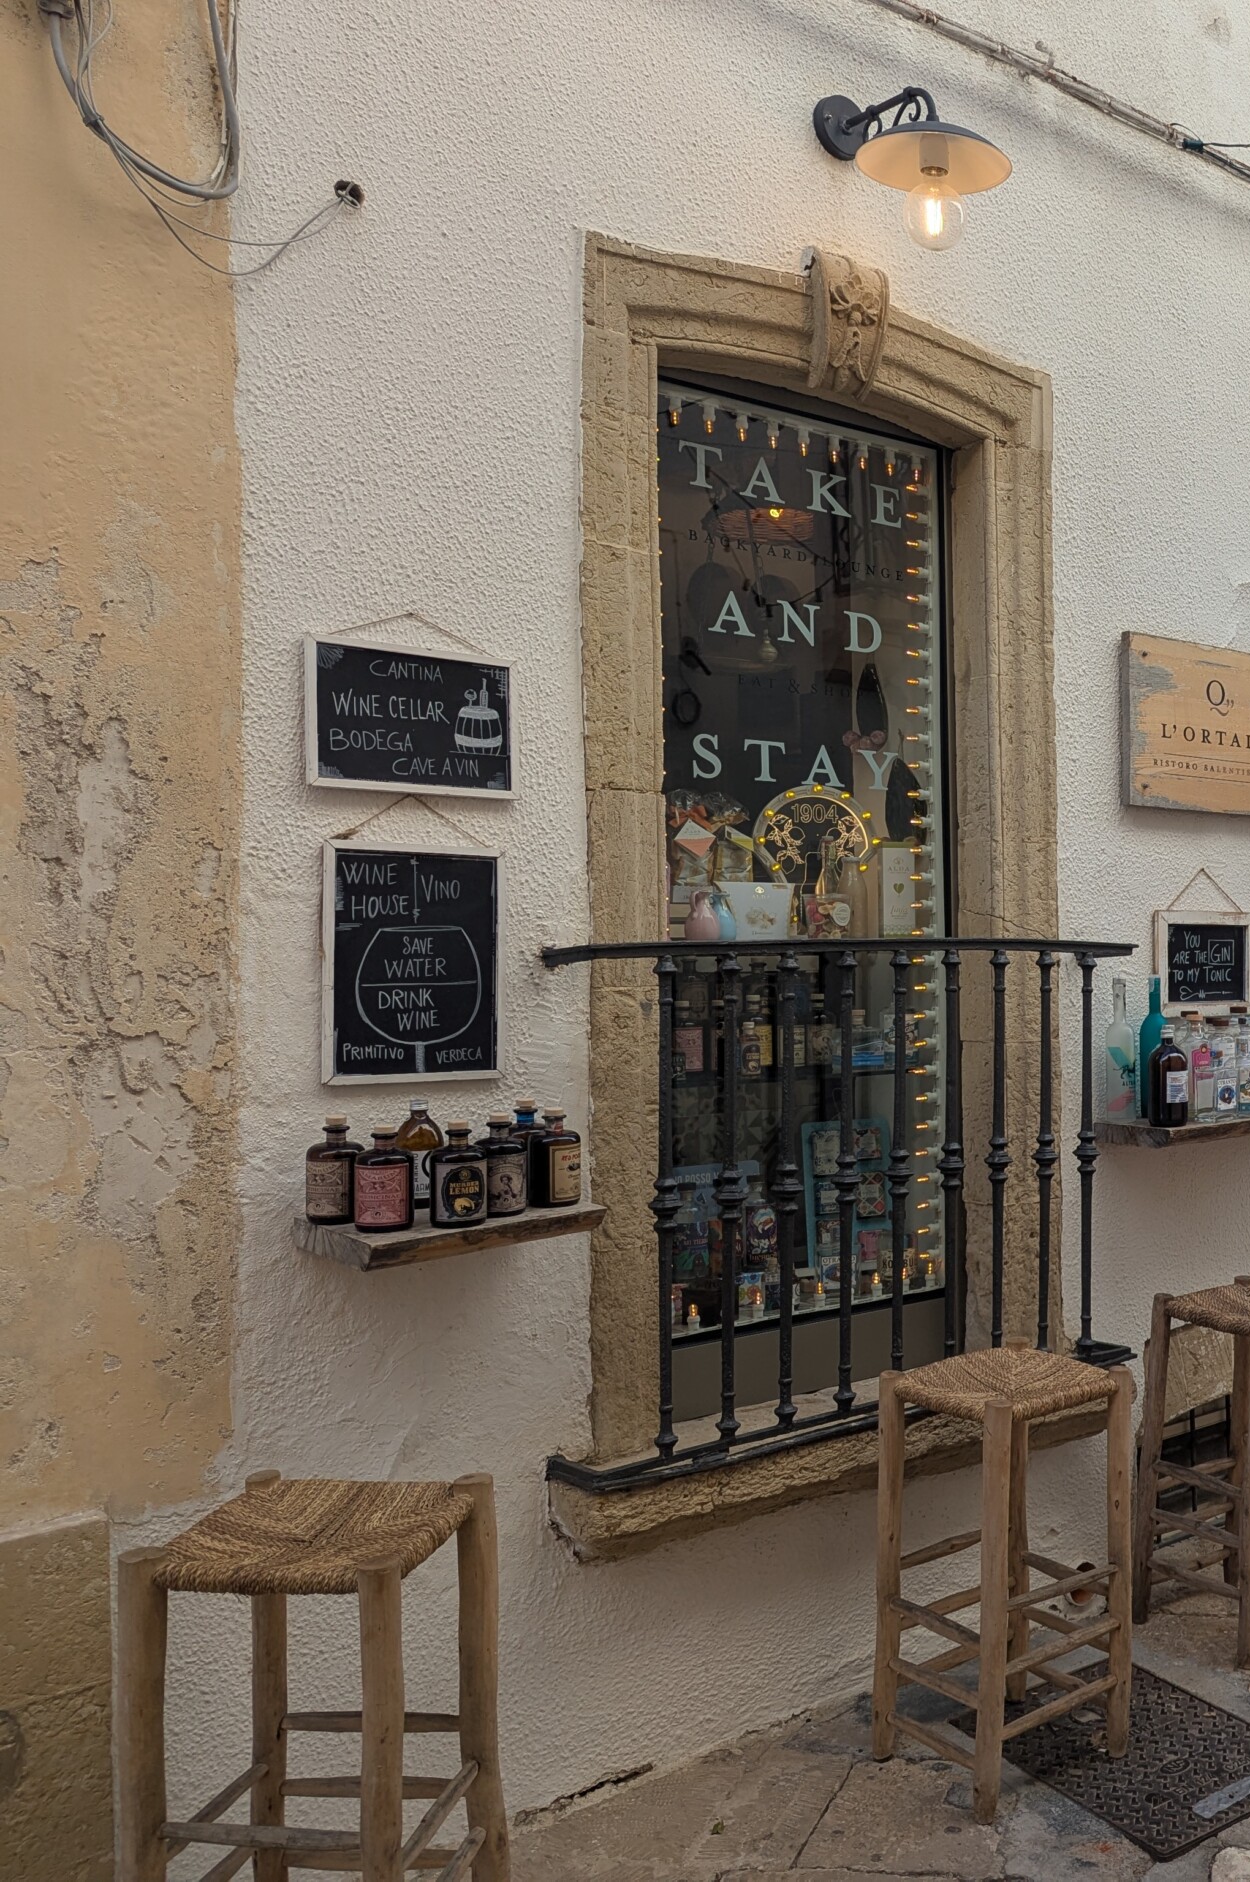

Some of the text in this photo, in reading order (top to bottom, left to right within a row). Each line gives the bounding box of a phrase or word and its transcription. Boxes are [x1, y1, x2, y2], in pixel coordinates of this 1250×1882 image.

[678, 439, 902, 529] TAKE
[689, 529, 807, 563] BACKYARD
[708, 590, 883, 654] AND
[369, 659, 443, 684] CANTINA
[738, 674, 775, 689] EAT
[332, 688, 450, 725] WINE CELLAR
[329, 728, 413, 752] BODEGA
[392, 757, 479, 778] CAVE A VIN
[692, 733, 899, 791] STAY
[1153, 758, 1199, 772] RISTORO
[791, 803, 839, 824] 1904
[342, 861, 398, 886] WINE
[421, 874, 461, 903] VINO
[351, 894, 410, 921] HOUSE
[402, 936, 434, 955] SAVE
[1183, 930, 1201, 949] YOU
[1172, 943, 1231, 965] ARE THE GIN
[384, 957, 447, 979] WATER
[1172, 965, 1232, 983] TO MY TONIC
[378, 988, 435, 1010] DRINK
[397, 1010, 440, 1031] WINE
[342, 1042, 482, 1064] PRIMITIVO VERDECA
[449, 1186, 480, 1199] LEMON
